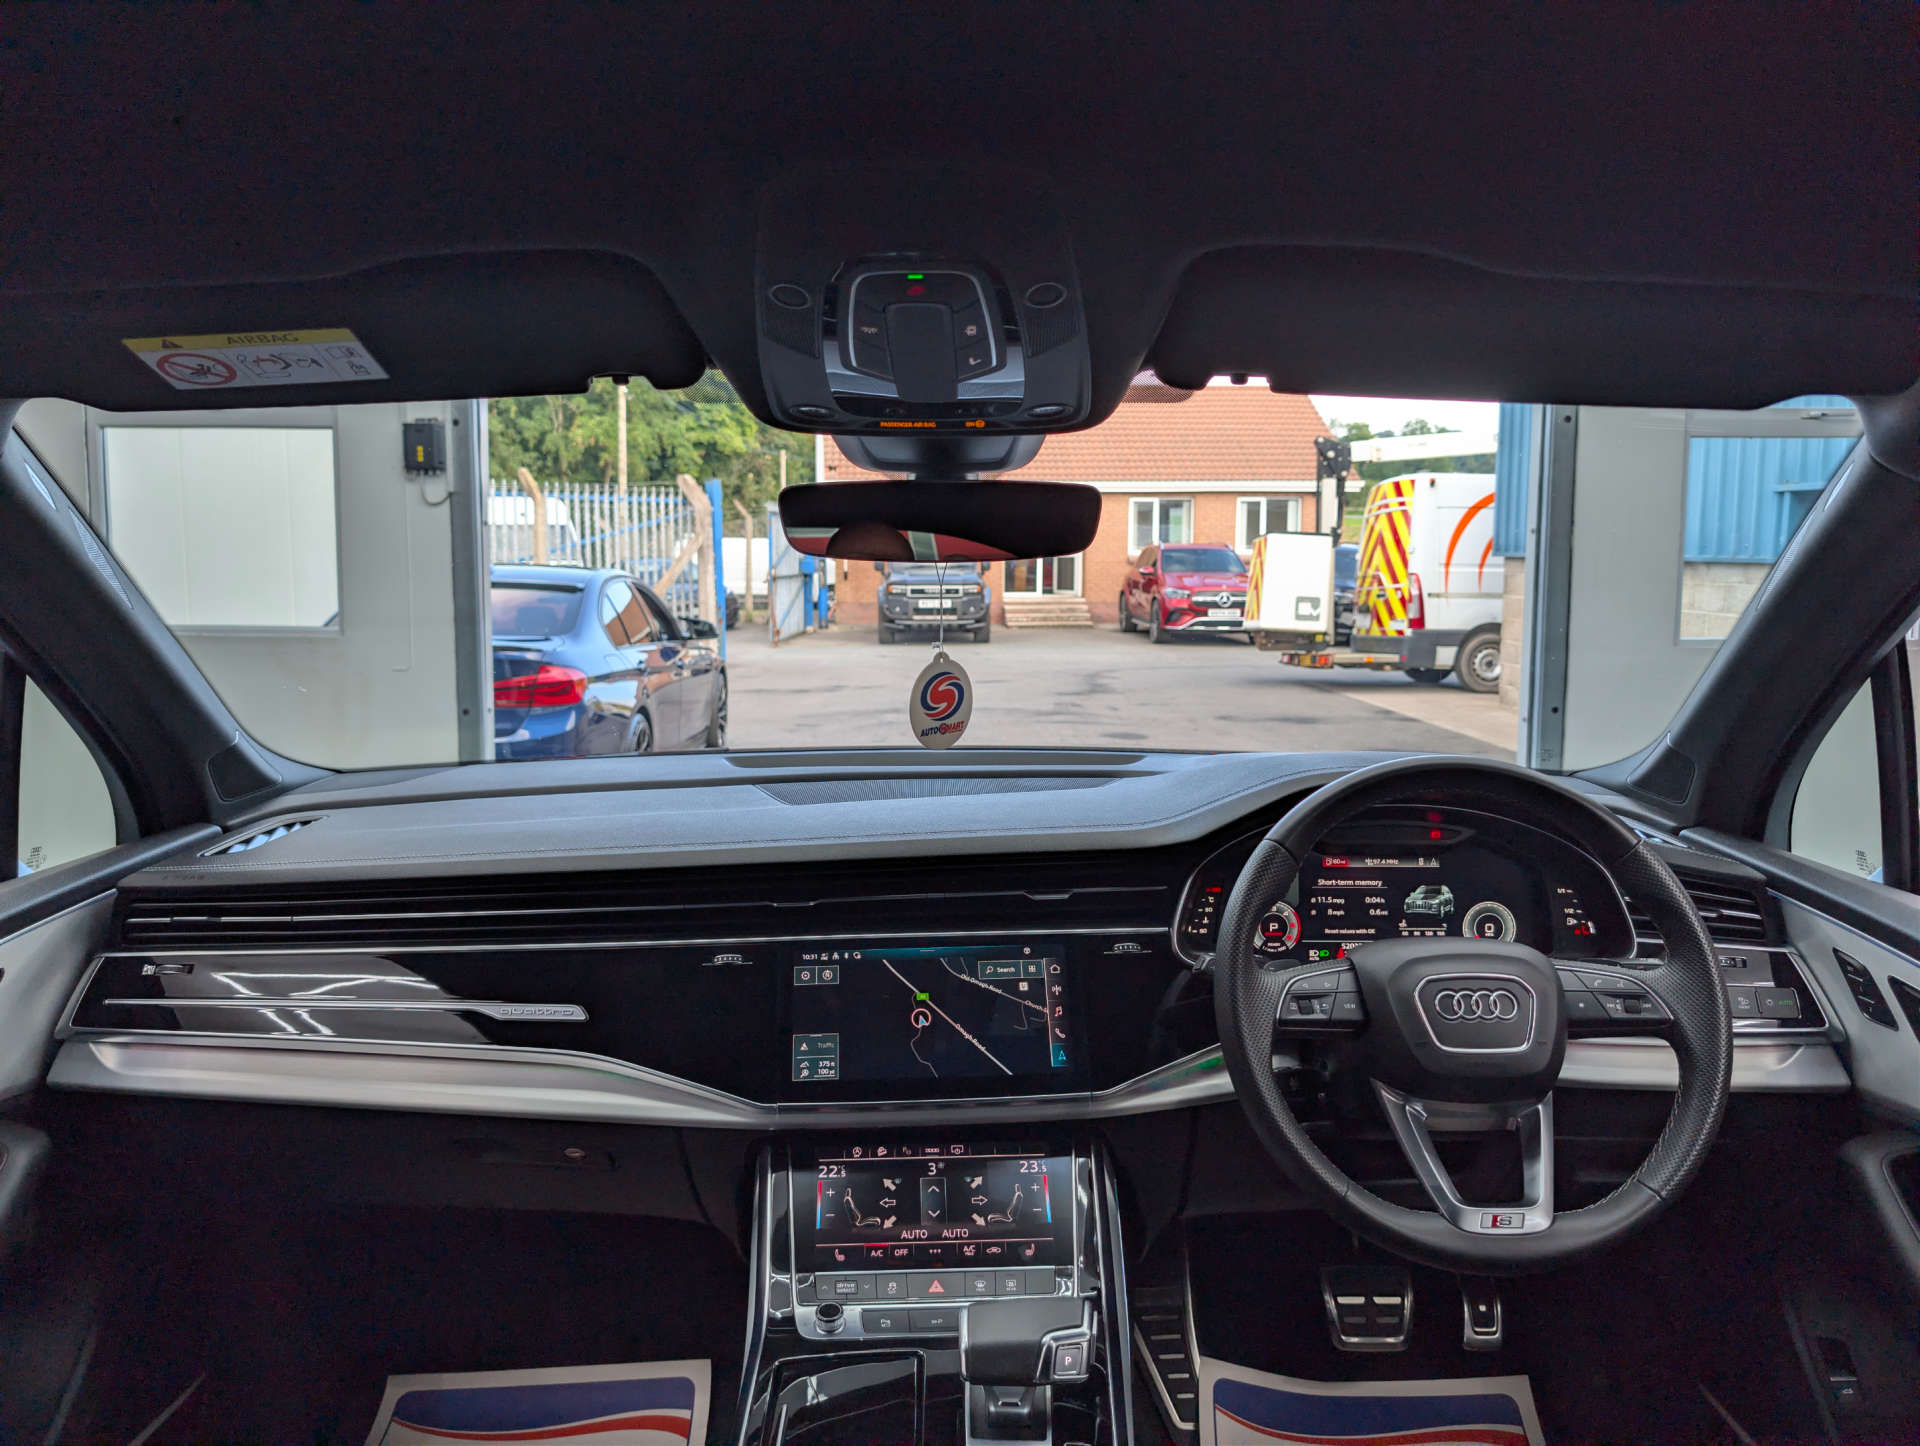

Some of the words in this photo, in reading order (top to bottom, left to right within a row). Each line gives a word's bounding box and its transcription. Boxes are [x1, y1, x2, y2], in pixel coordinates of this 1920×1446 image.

[226, 332, 300, 345] AIRBAG
[1270, 923, 1278, 932] P
[501, 1007, 574, 1016] quattro
[901, 1229, 928, 1239] AUTO
[942, 1228, 969, 1238] AUTO
[871, 1249, 883, 1257] A/C
[894, 1248, 908, 1256] OFF
[1065, 1356, 1072, 1366] P
